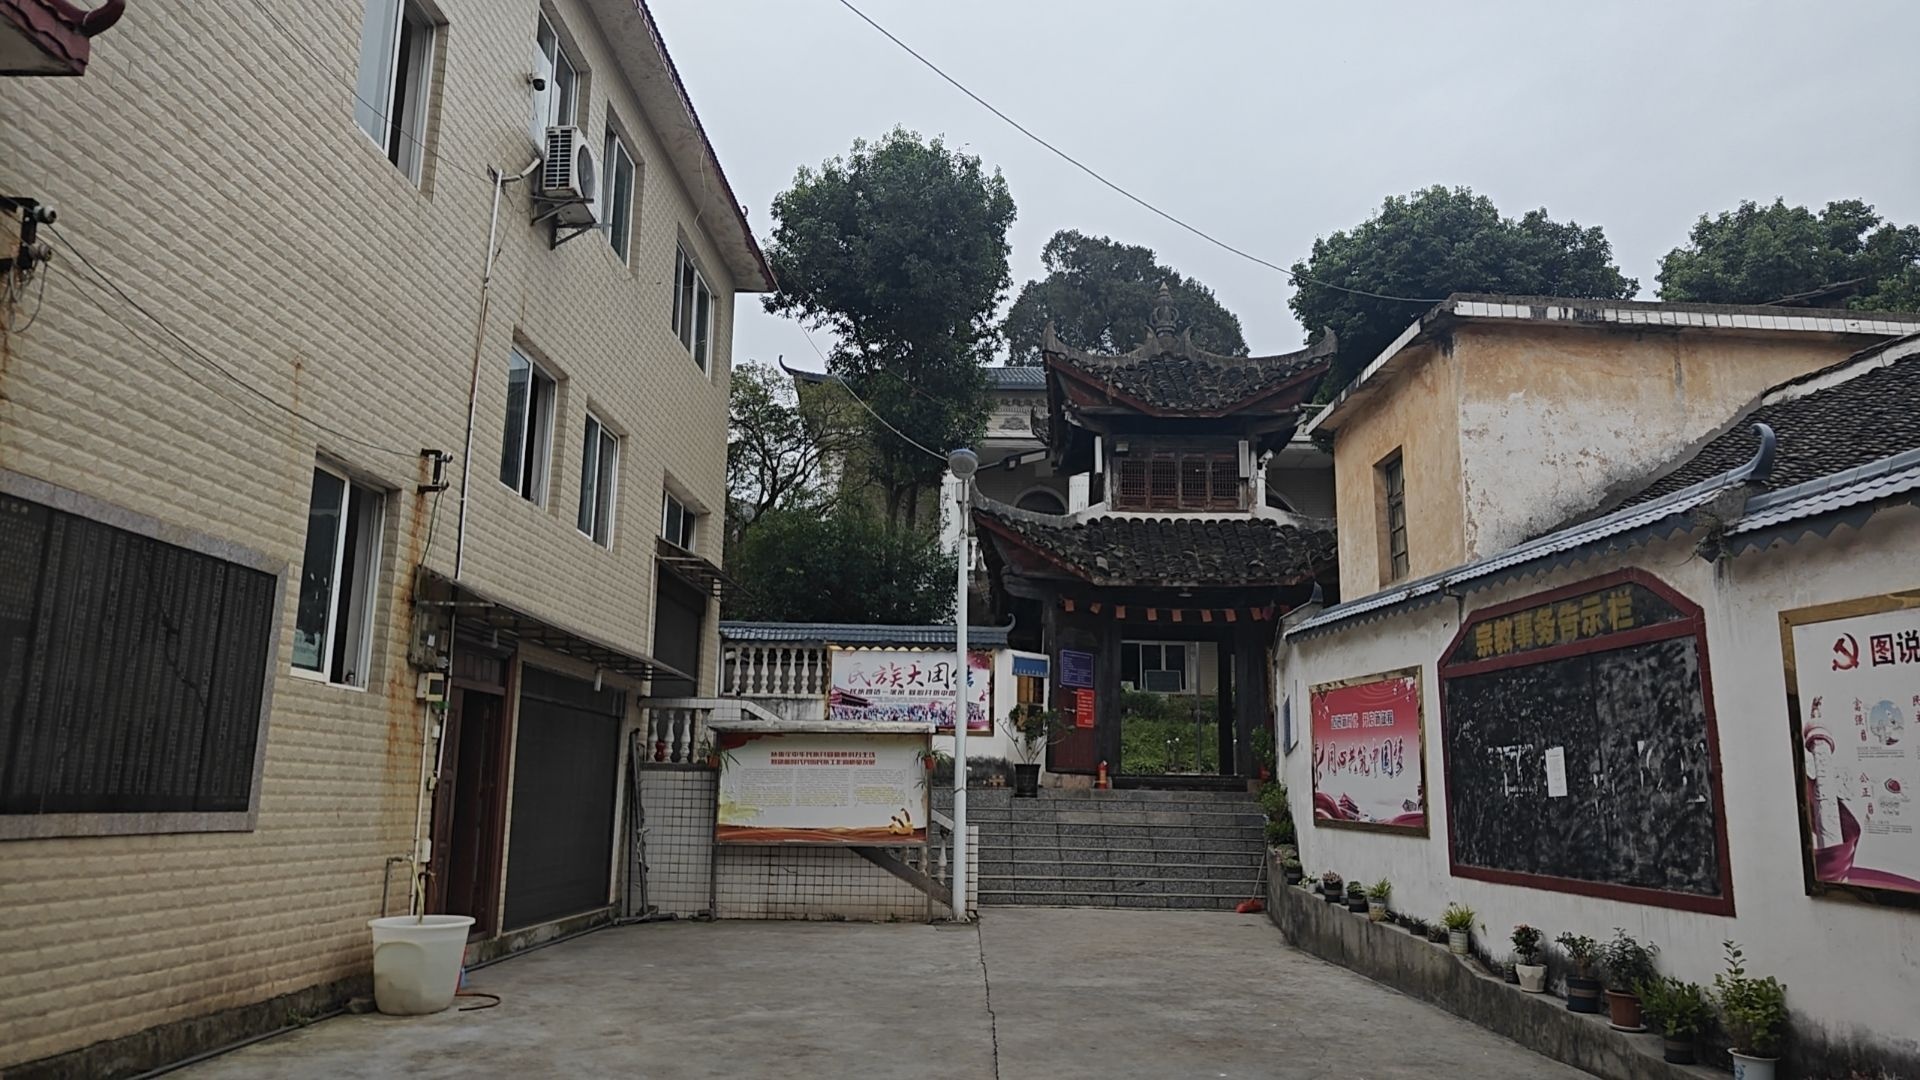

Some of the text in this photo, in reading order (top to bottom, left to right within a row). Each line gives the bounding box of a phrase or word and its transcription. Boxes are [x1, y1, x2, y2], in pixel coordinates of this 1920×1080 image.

[1475, 589, 1635, 657] 宗教事务告示栏
[1870, 629, 1920, 667] 图说
[1859, 772, 1871, 797] 公正
